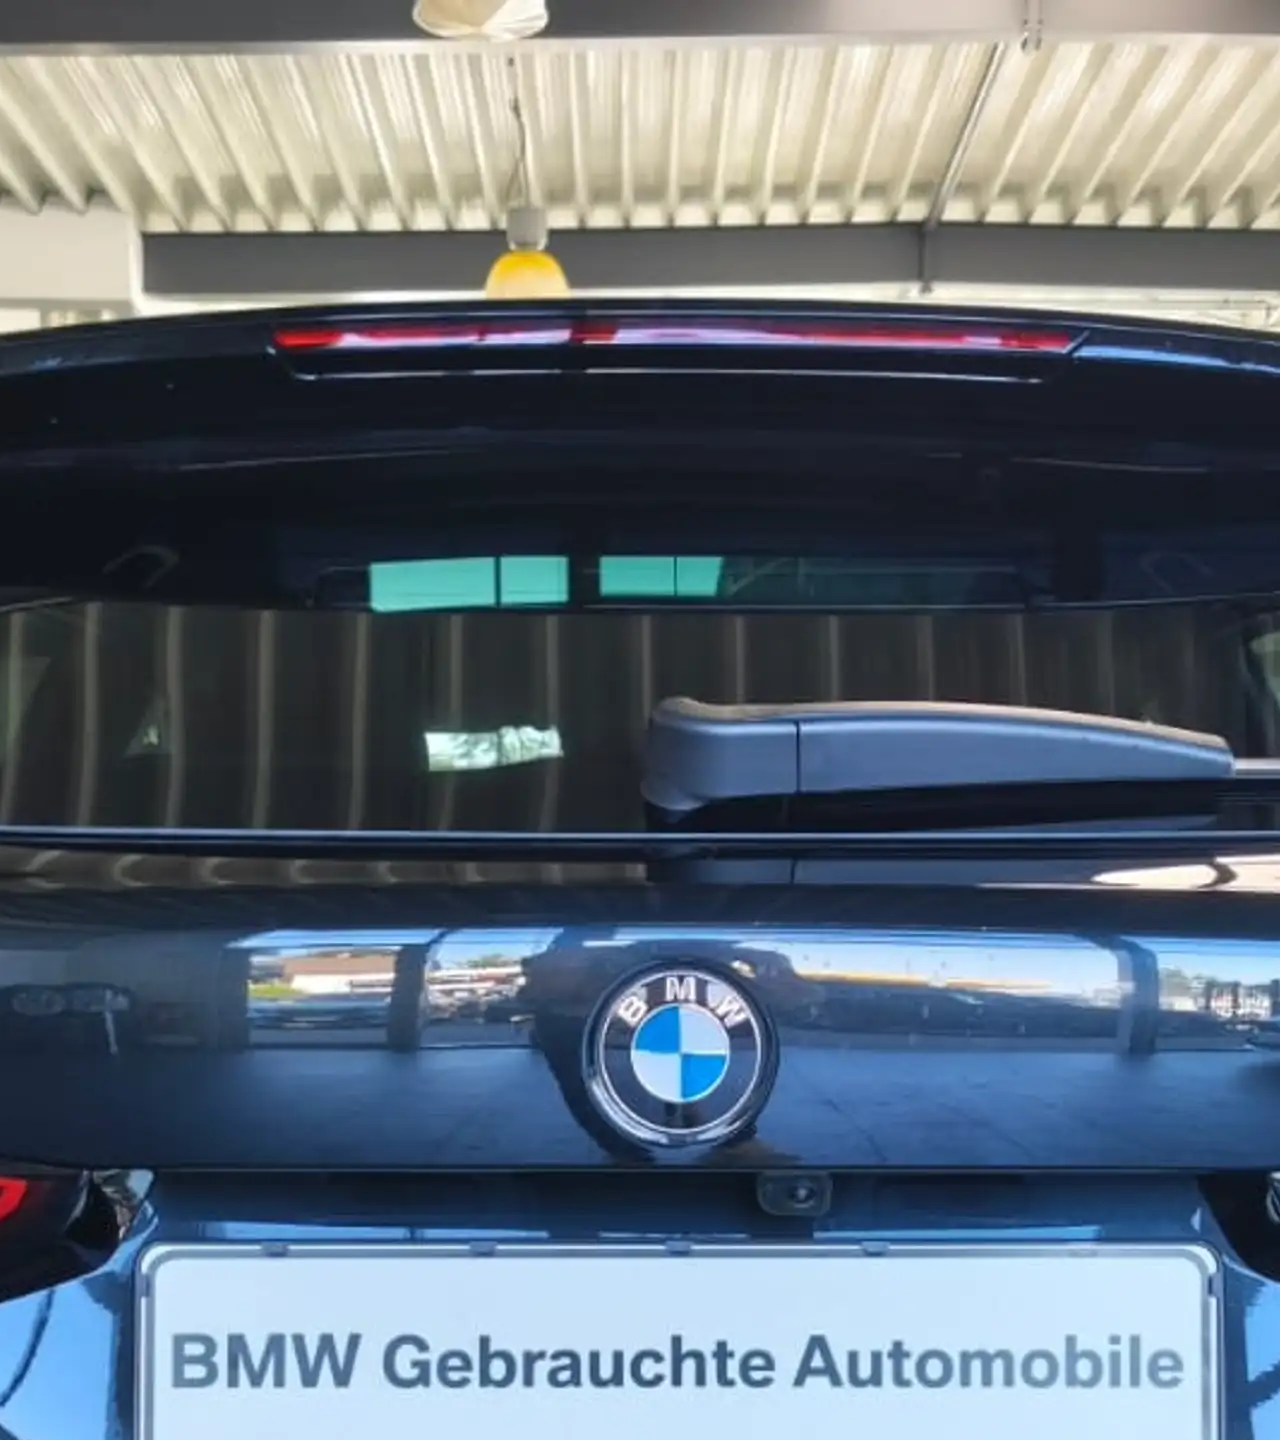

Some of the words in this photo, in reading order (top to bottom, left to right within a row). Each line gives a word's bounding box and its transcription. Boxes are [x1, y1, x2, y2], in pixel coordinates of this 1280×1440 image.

[617, 975, 749, 1029] BMW
[170, 1332, 363, 1390] BMW
[382, 1333, 776, 1390] Gebrauchte
[792, 1333, 1185, 1390] Automobile
